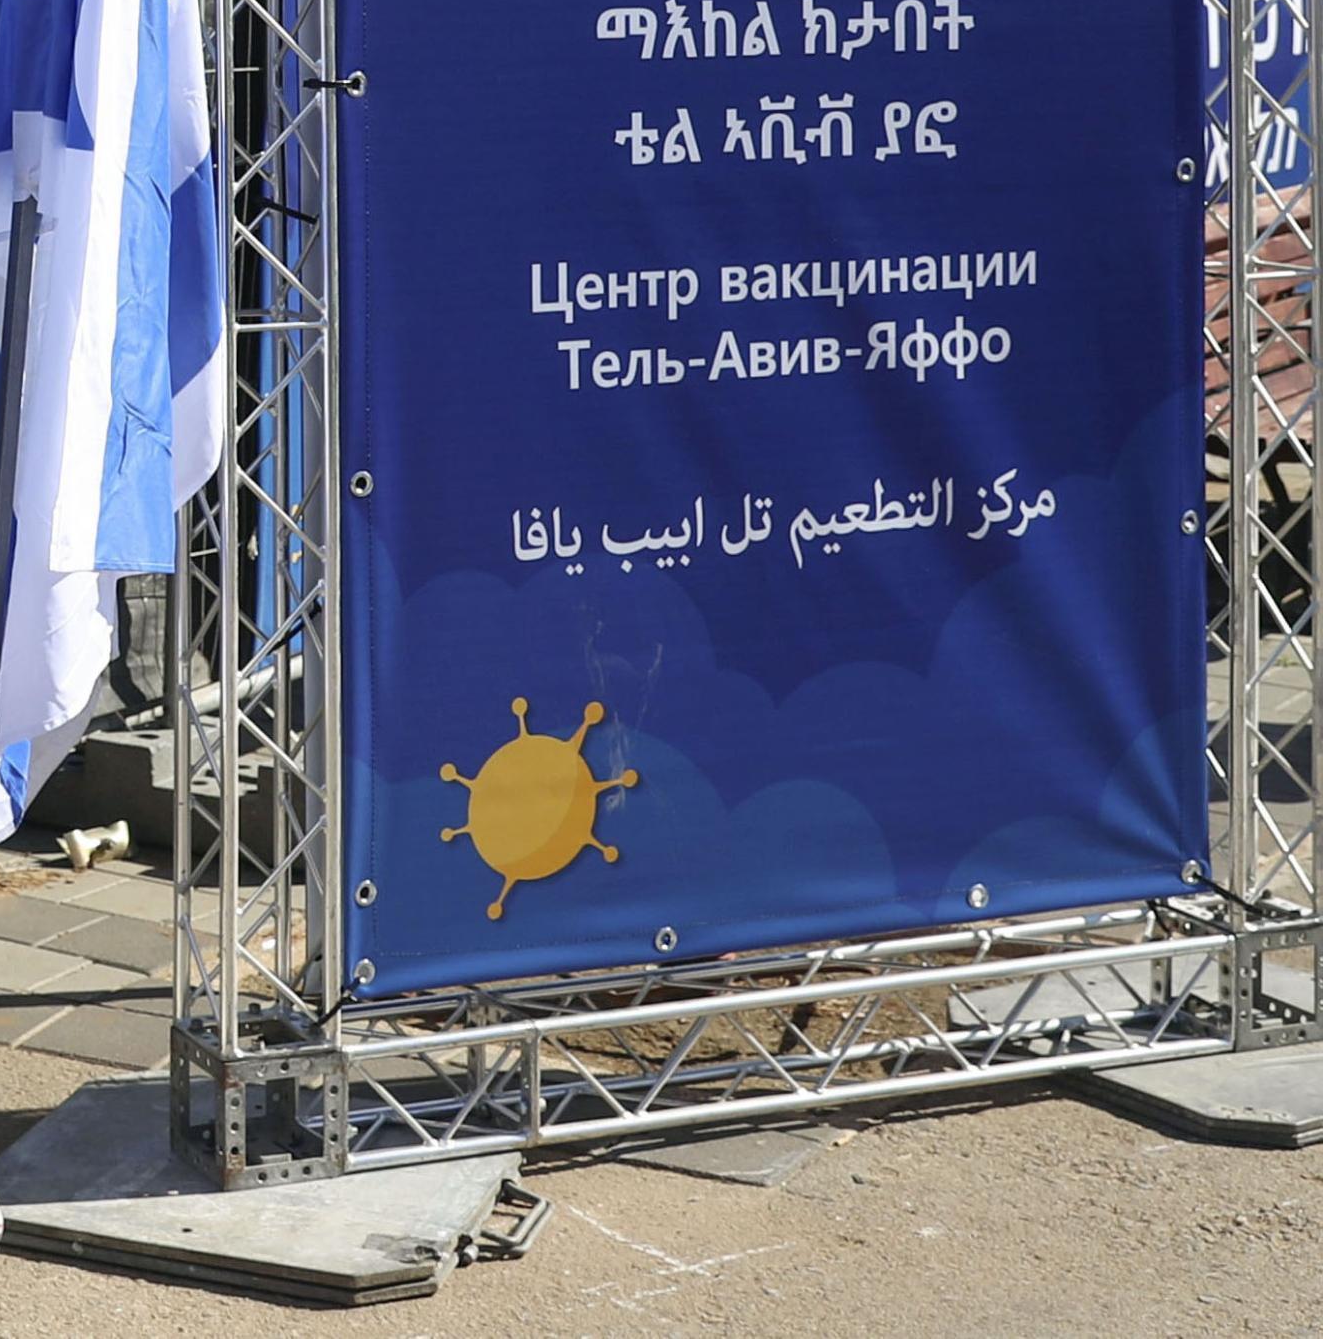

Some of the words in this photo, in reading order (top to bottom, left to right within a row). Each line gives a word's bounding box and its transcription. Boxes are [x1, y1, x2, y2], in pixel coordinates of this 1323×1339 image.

[531, 262, 700, 324] Центр
[721, 250, 1038, 308] вакцинации
[558, 316, 1012, 390] Тель-Авив-Яффо
[512, 506, 585, 576] يافا
[601, 495, 705, 574] ابيب
[721, 493, 774, 556] تل
[790, 476, 954, 569] التطعيم
[967, 468, 1057, 540] مركز
